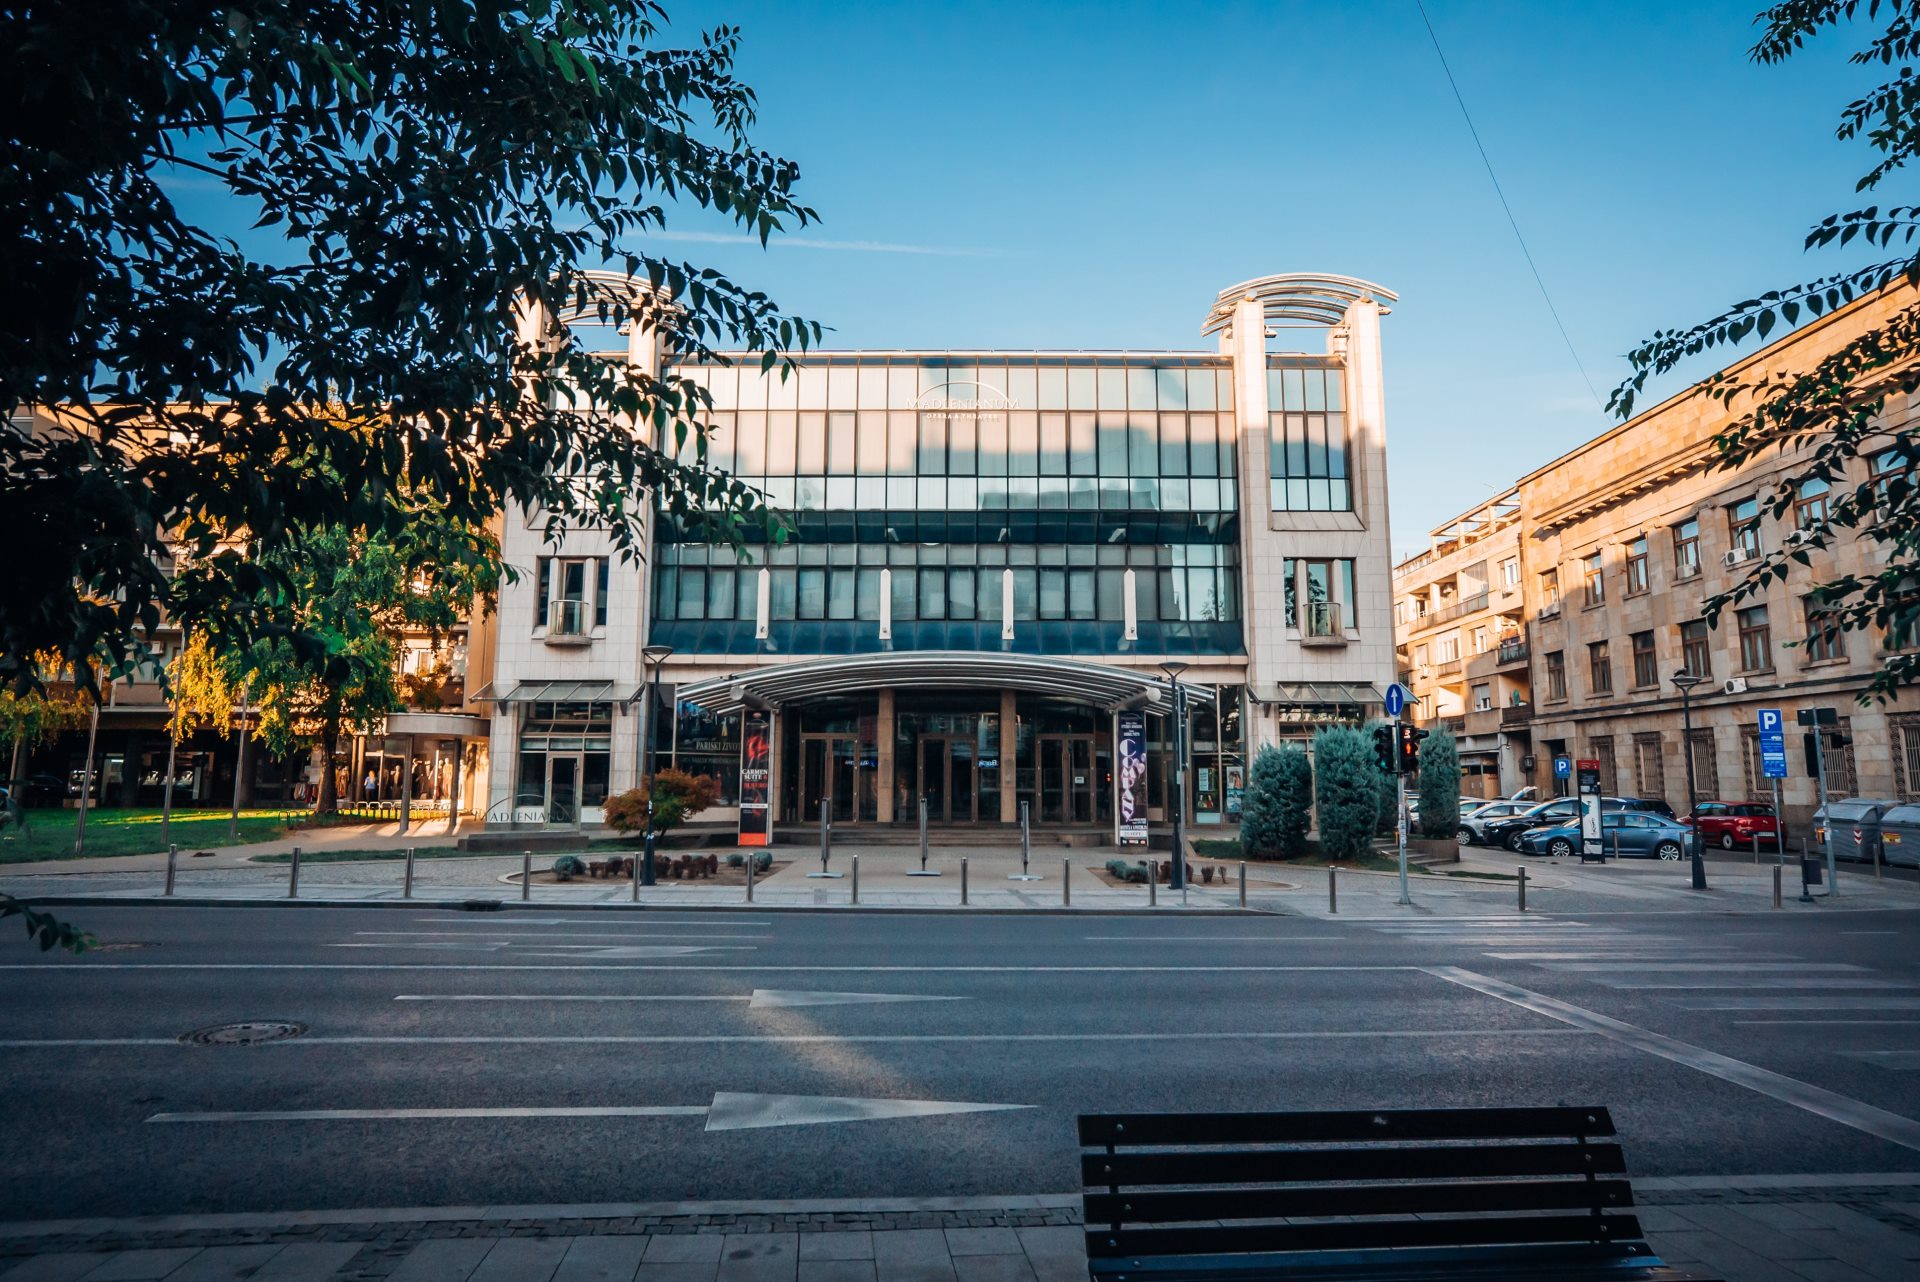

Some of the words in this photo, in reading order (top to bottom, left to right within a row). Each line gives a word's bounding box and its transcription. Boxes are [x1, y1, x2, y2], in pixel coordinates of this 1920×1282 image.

[905, 398, 1020, 409] MADLENIANUM
[1763, 712, 1777, 730] P
[1558, 761, 1567, 772] P
